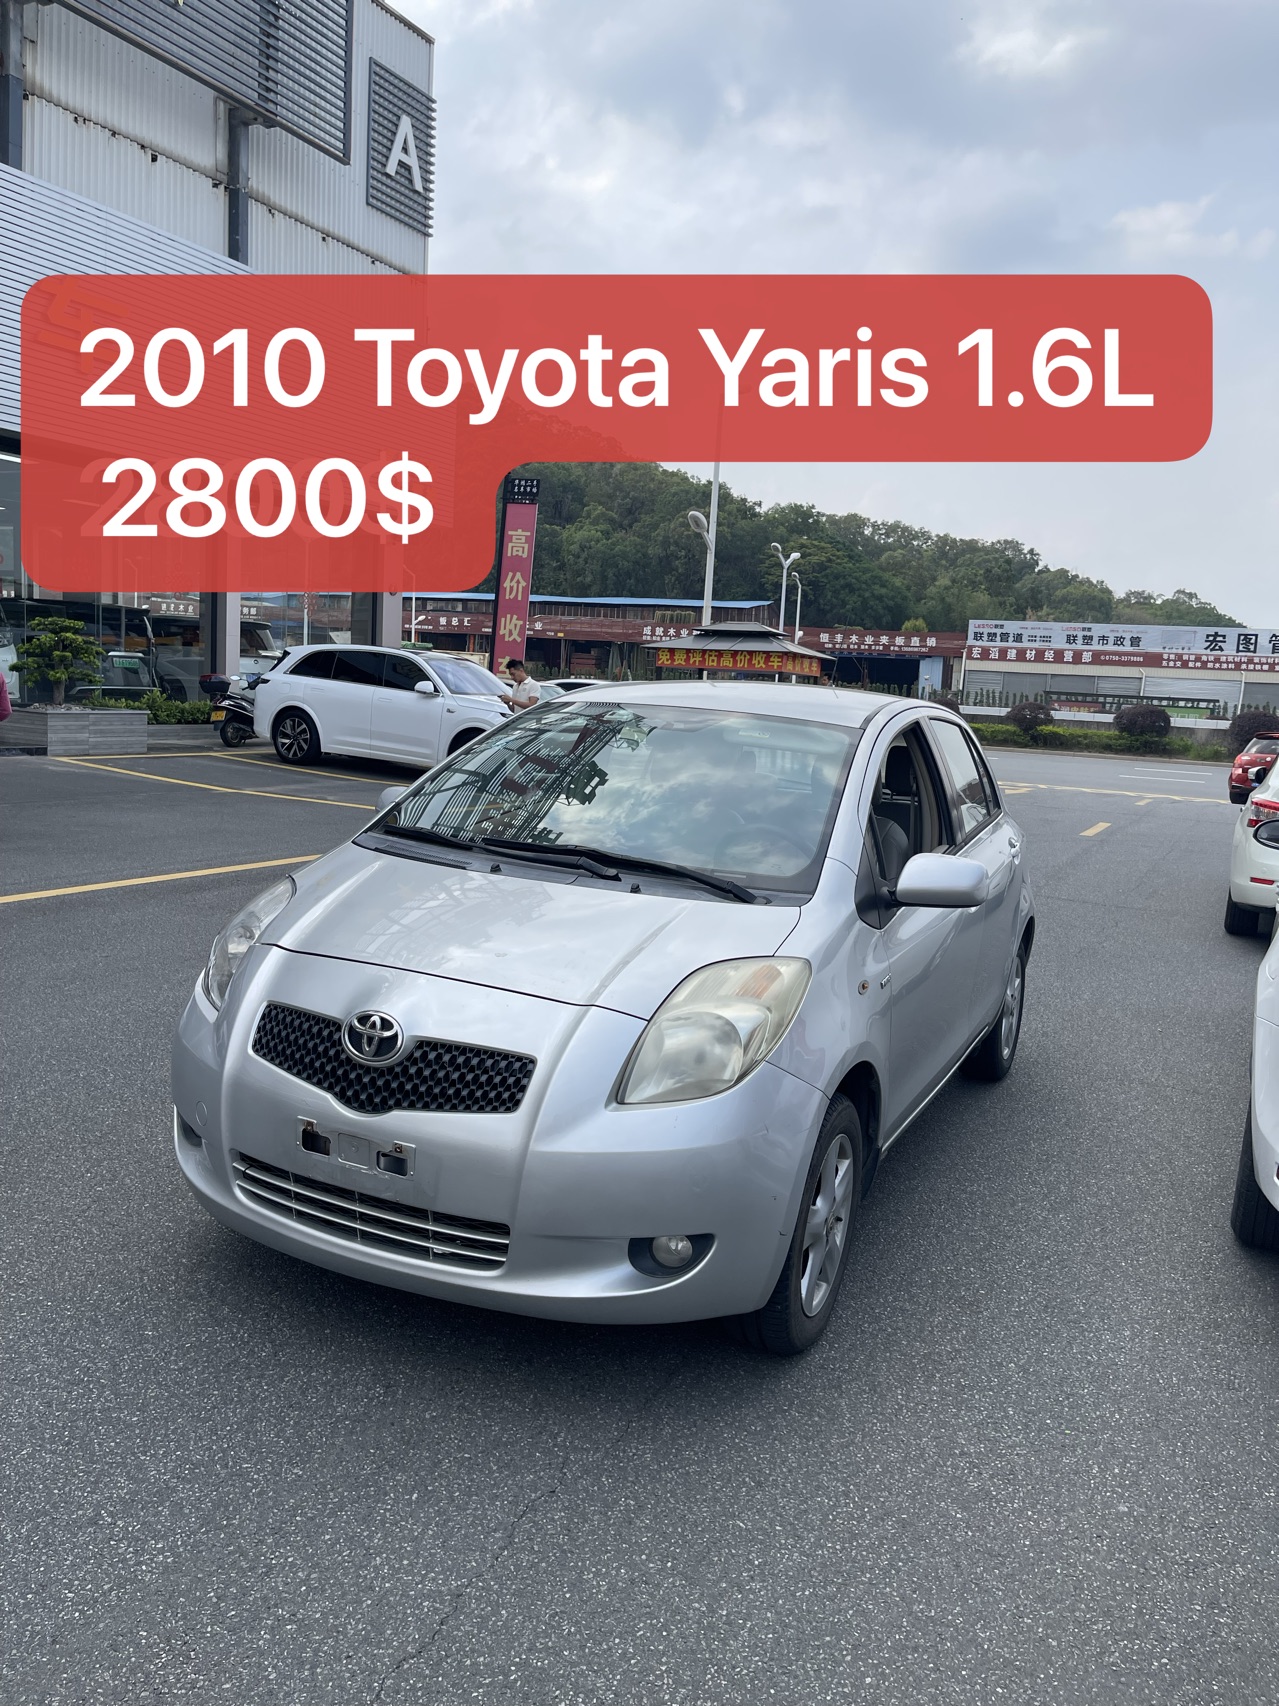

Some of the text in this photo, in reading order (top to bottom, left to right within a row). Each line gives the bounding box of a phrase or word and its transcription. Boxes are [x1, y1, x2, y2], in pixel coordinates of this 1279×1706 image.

[385, 114, 424, 193] A
[820, 632, 937, 647] 恒丰木业夹板直销
[972, 631, 1024, 644] 联塑管道
[1065, 633, 1143, 648] 联塑市政管
[658, 648, 782, 669] 免费评估高价收车
